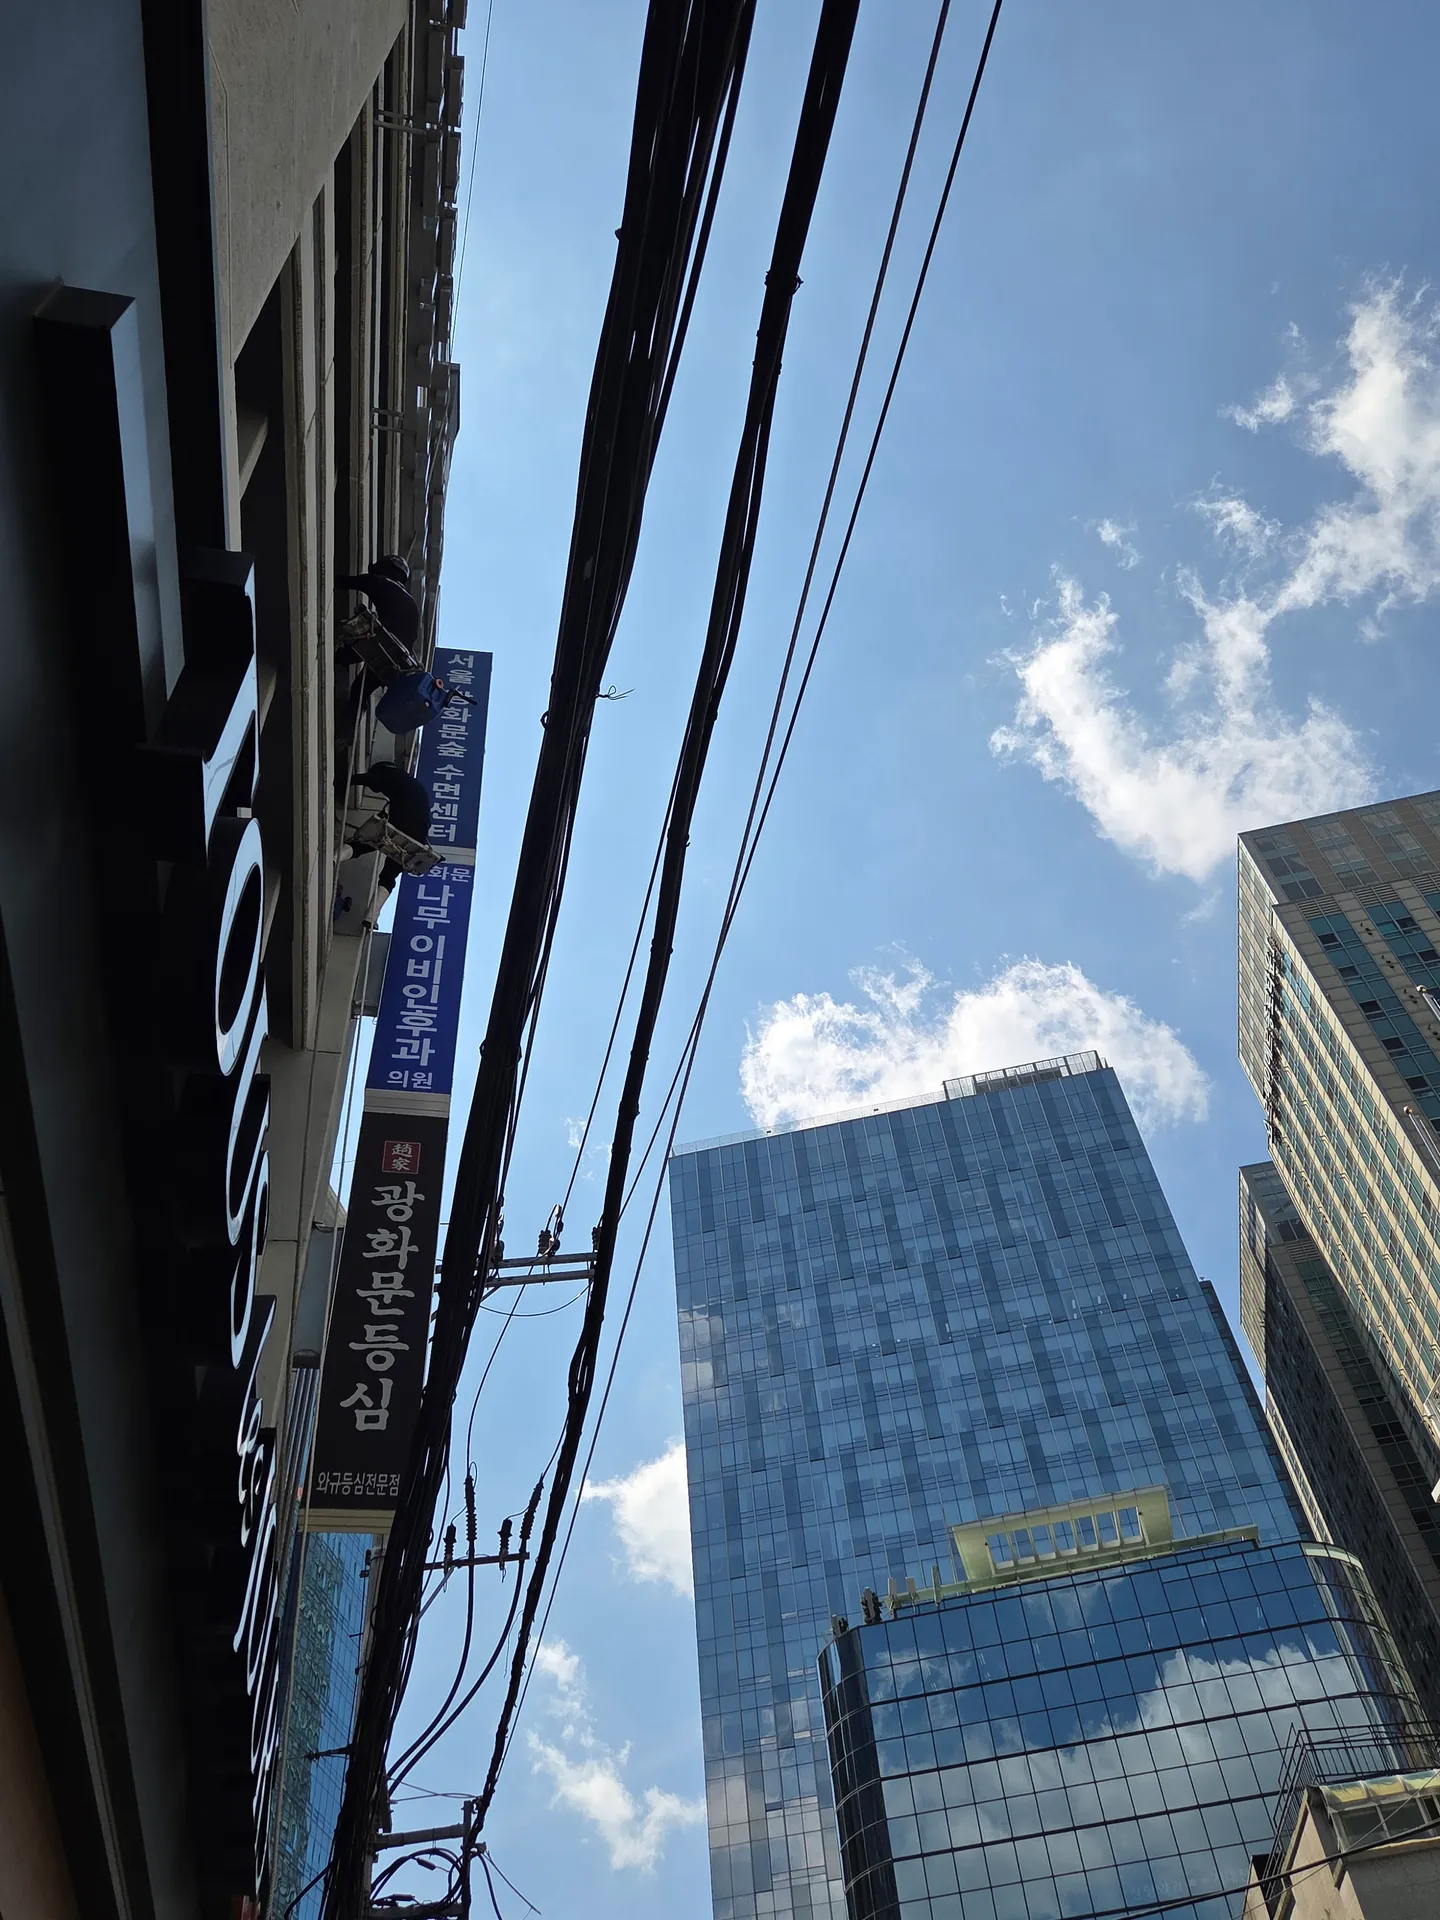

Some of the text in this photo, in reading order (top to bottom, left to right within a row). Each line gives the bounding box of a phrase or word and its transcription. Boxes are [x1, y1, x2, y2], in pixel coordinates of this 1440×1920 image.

[428, 764, 465, 842] 수면센터
[408, 865, 472, 883] 화문
[203, 555, 269, 1369] TOUS
[387, 1070, 433, 1090] 의원
[340, 1180, 425, 1433] 광화문등심
[316, 1471, 400, 1497] 와규등심전문점
